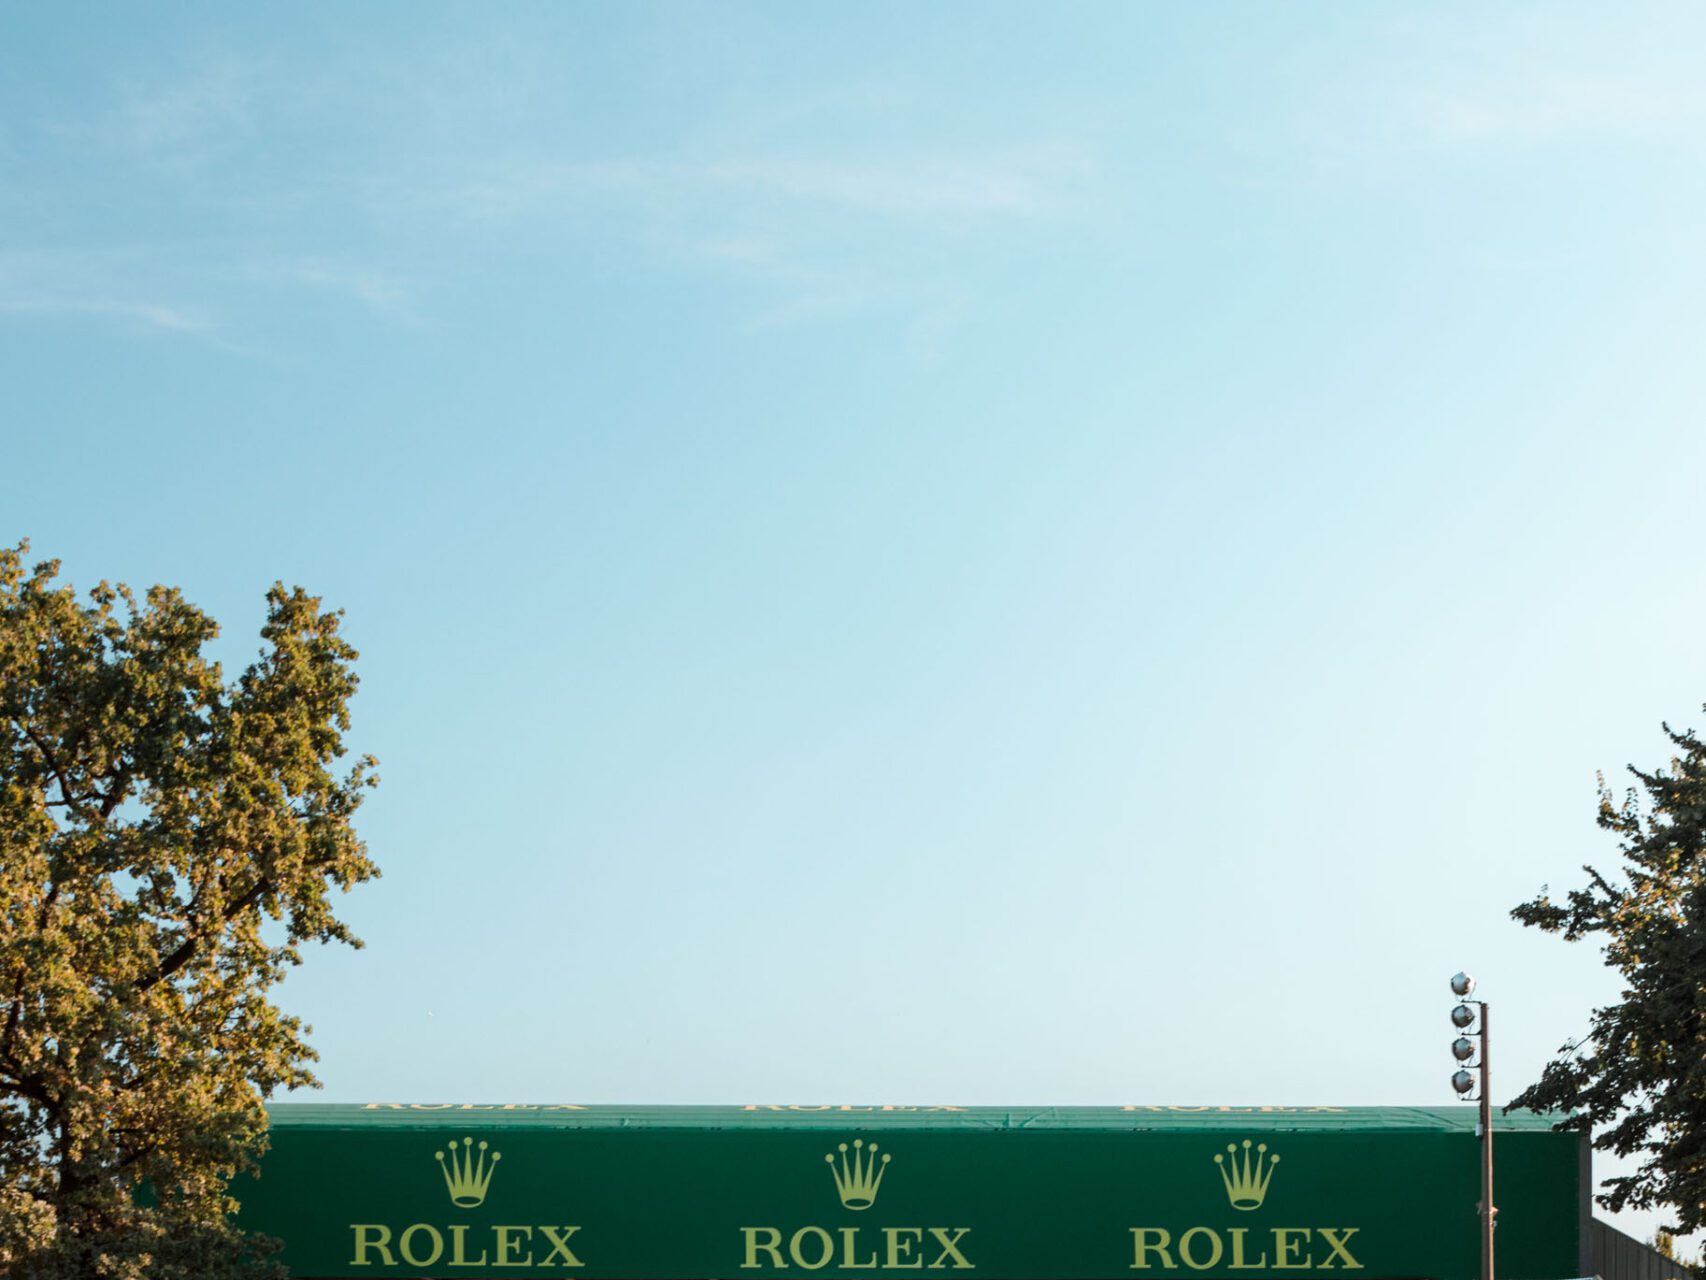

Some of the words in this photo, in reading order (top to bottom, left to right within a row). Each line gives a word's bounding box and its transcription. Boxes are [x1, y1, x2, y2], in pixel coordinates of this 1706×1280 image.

[351, 1224, 584, 1267] ROLEX
[741, 1226, 975, 1270] ROLEX
[1130, 1226, 1365, 1270] ROLEX
